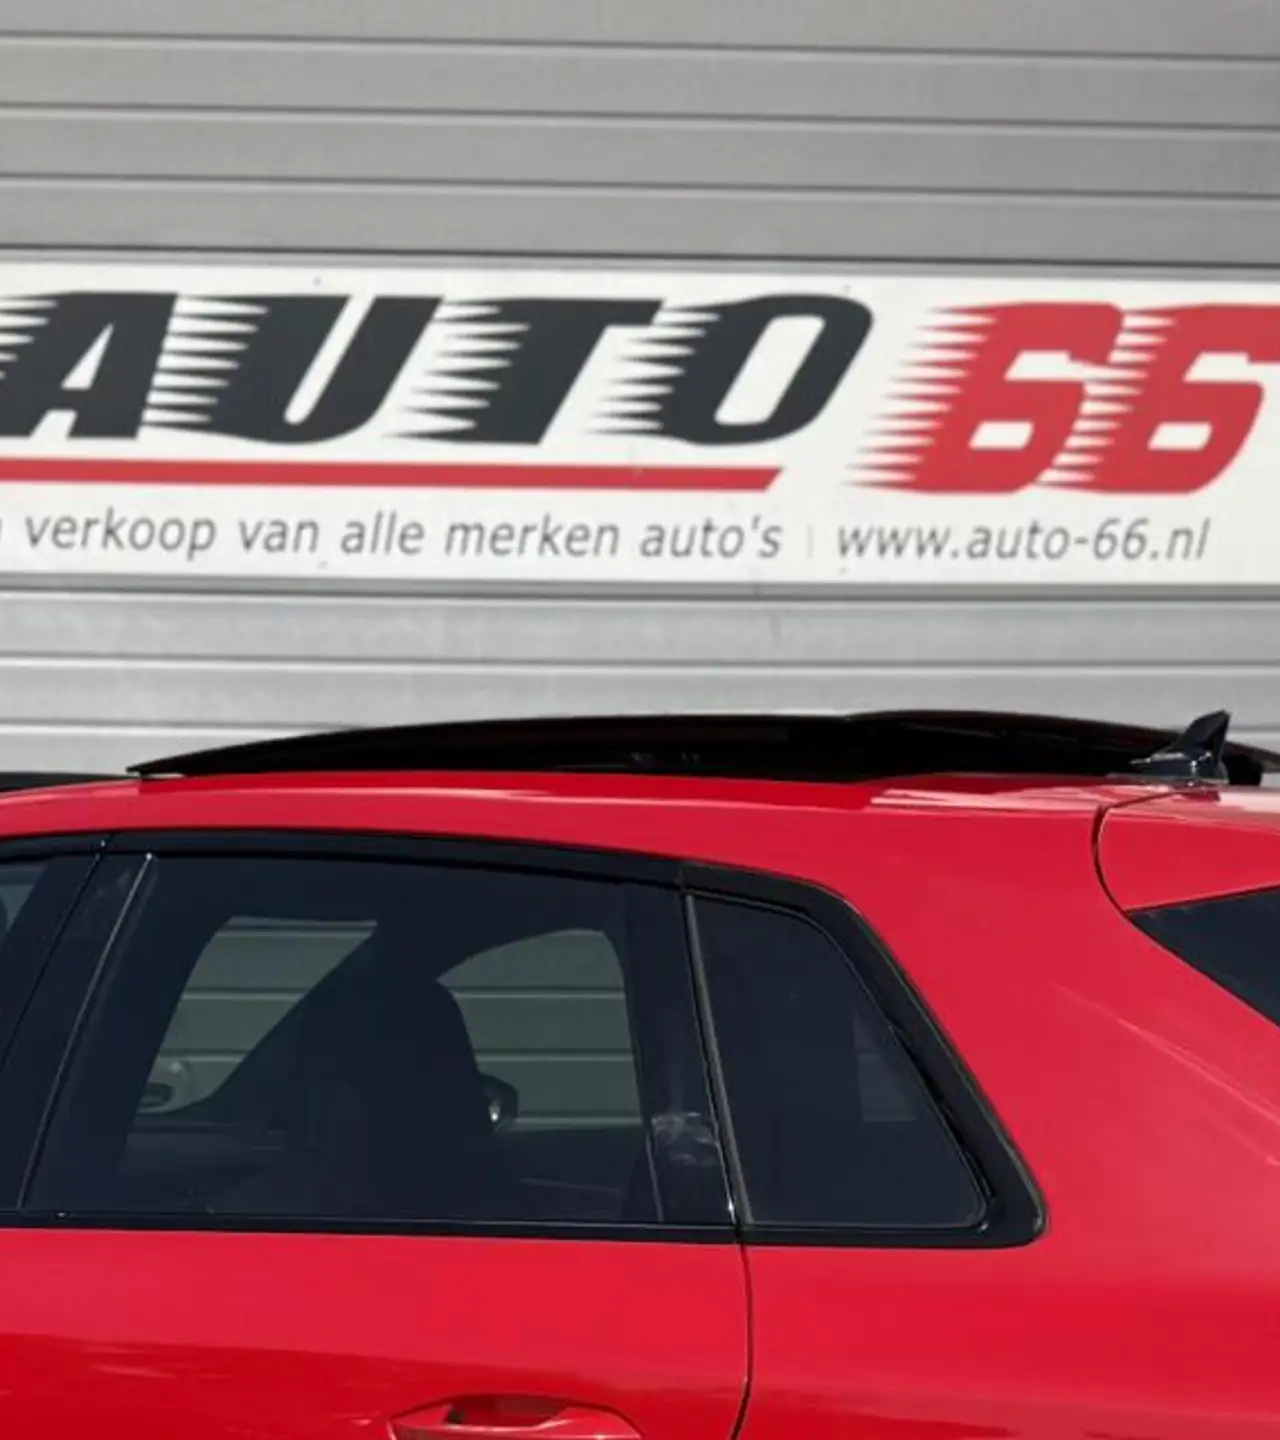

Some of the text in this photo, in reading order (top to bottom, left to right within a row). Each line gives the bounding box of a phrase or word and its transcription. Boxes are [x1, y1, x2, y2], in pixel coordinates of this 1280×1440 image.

[24, 508, 217, 561] verkoop
[237, 519, 320, 553] van
[340, 511, 425, 555] alle
[445, 515, 620, 557] merken
[639, 515, 782, 559] auto's
[837, 517, 1212, 561] www.auto-66.nl
